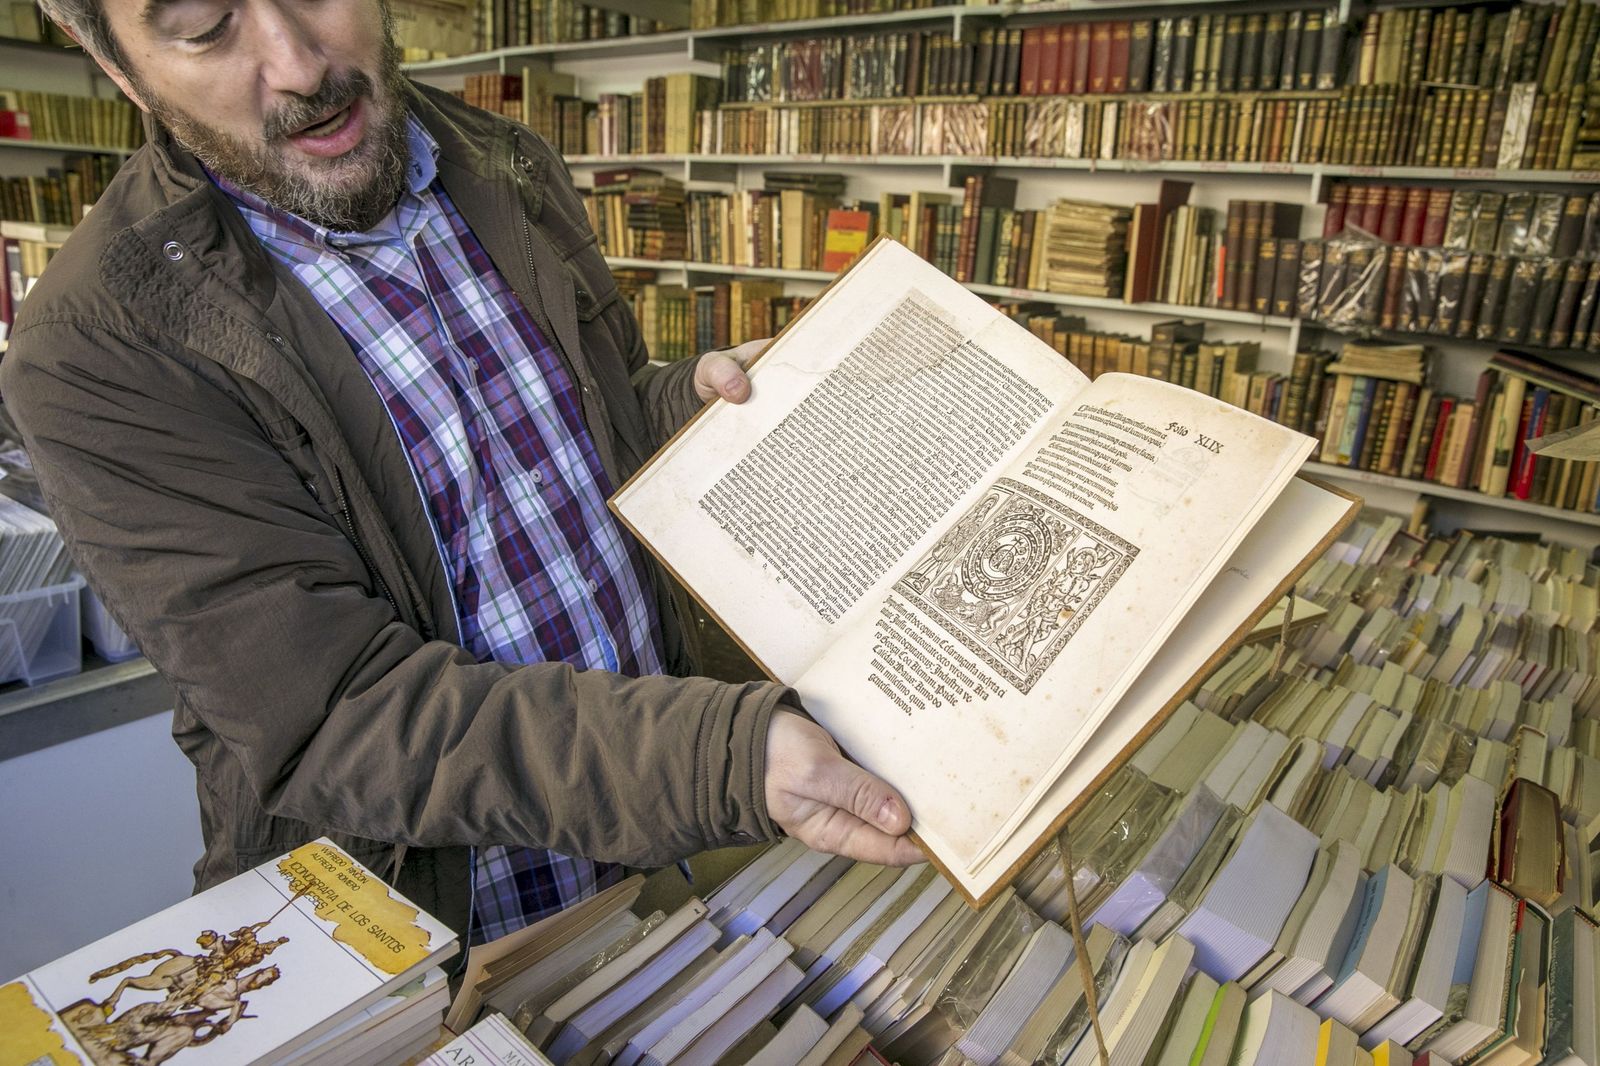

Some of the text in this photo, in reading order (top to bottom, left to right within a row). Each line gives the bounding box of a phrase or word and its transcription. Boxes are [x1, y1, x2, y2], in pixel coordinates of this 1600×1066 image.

[1193, 433, 1224, 454] XLIX
[932, 634, 941, 644] in
[321, 846, 347, 867] WIFREDO
[311, 852, 361, 891] ALFREDO ROMERO
[336, 900, 353, 913] DE
[348, 910, 371, 927] LOS
[367, 924, 405, 953] SANTOS
